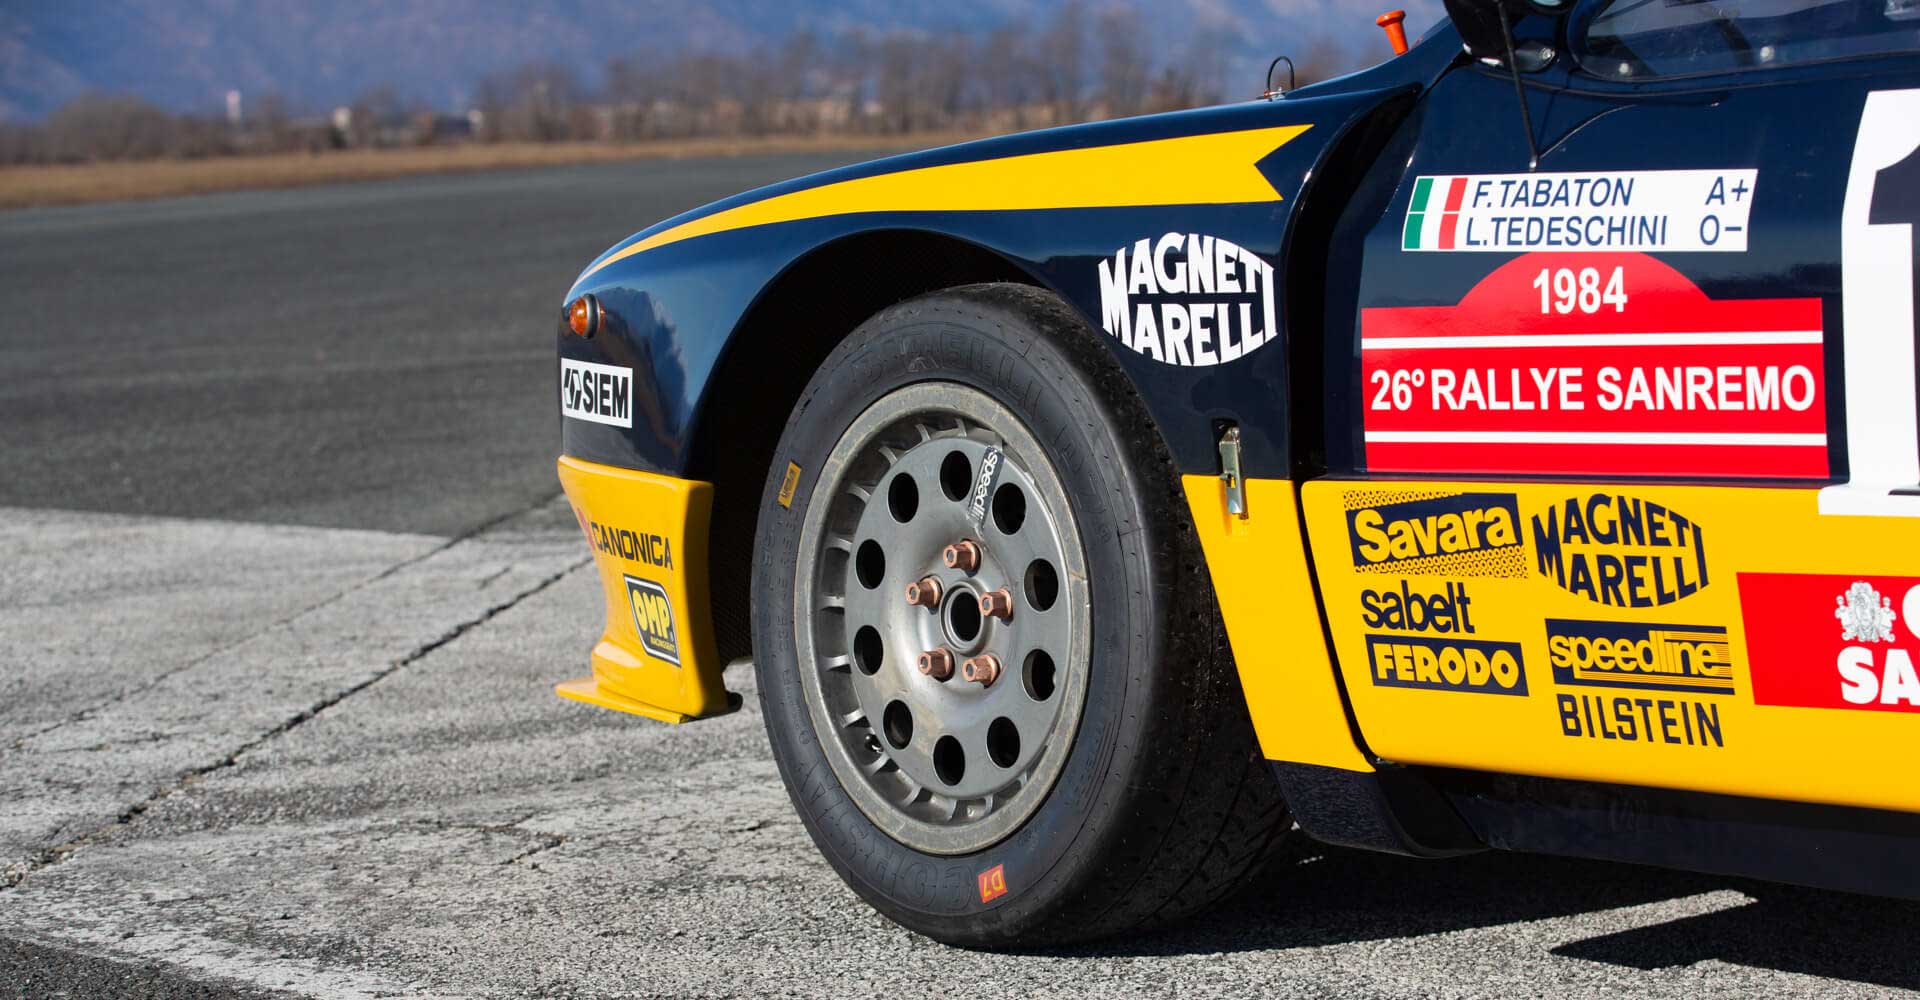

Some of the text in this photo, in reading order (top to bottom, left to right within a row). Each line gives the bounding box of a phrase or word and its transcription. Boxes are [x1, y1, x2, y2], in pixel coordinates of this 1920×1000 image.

[1471, 175, 1749, 209] F.TABATON A+
[1465, 214, 1668, 247] L.TEDESCHINI
[1097, 231, 1276, 297] MAGNETI
[1532, 265, 1629, 315] 1984
[1097, 301, 1278, 368] MARELLI
[582, 374, 630, 420] SIEM
[1430, 366, 1585, 412] RALLYE
[1596, 364, 1816, 412] SANREMO
[590, 521, 674, 571] CANONICA
[1354, 505, 1518, 563] Savara
[1531, 493, 1703, 548] MAGNETI
[1538, 552, 1710, 608] MARELLI
[632, 589, 671, 640] OMP
[1360, 579, 1476, 634] sabelt
[1372, 641, 1520, 689] FERODO
[1549, 629, 1721, 680] speedline
[1555, 692, 1725, 748] BILSTEIN
